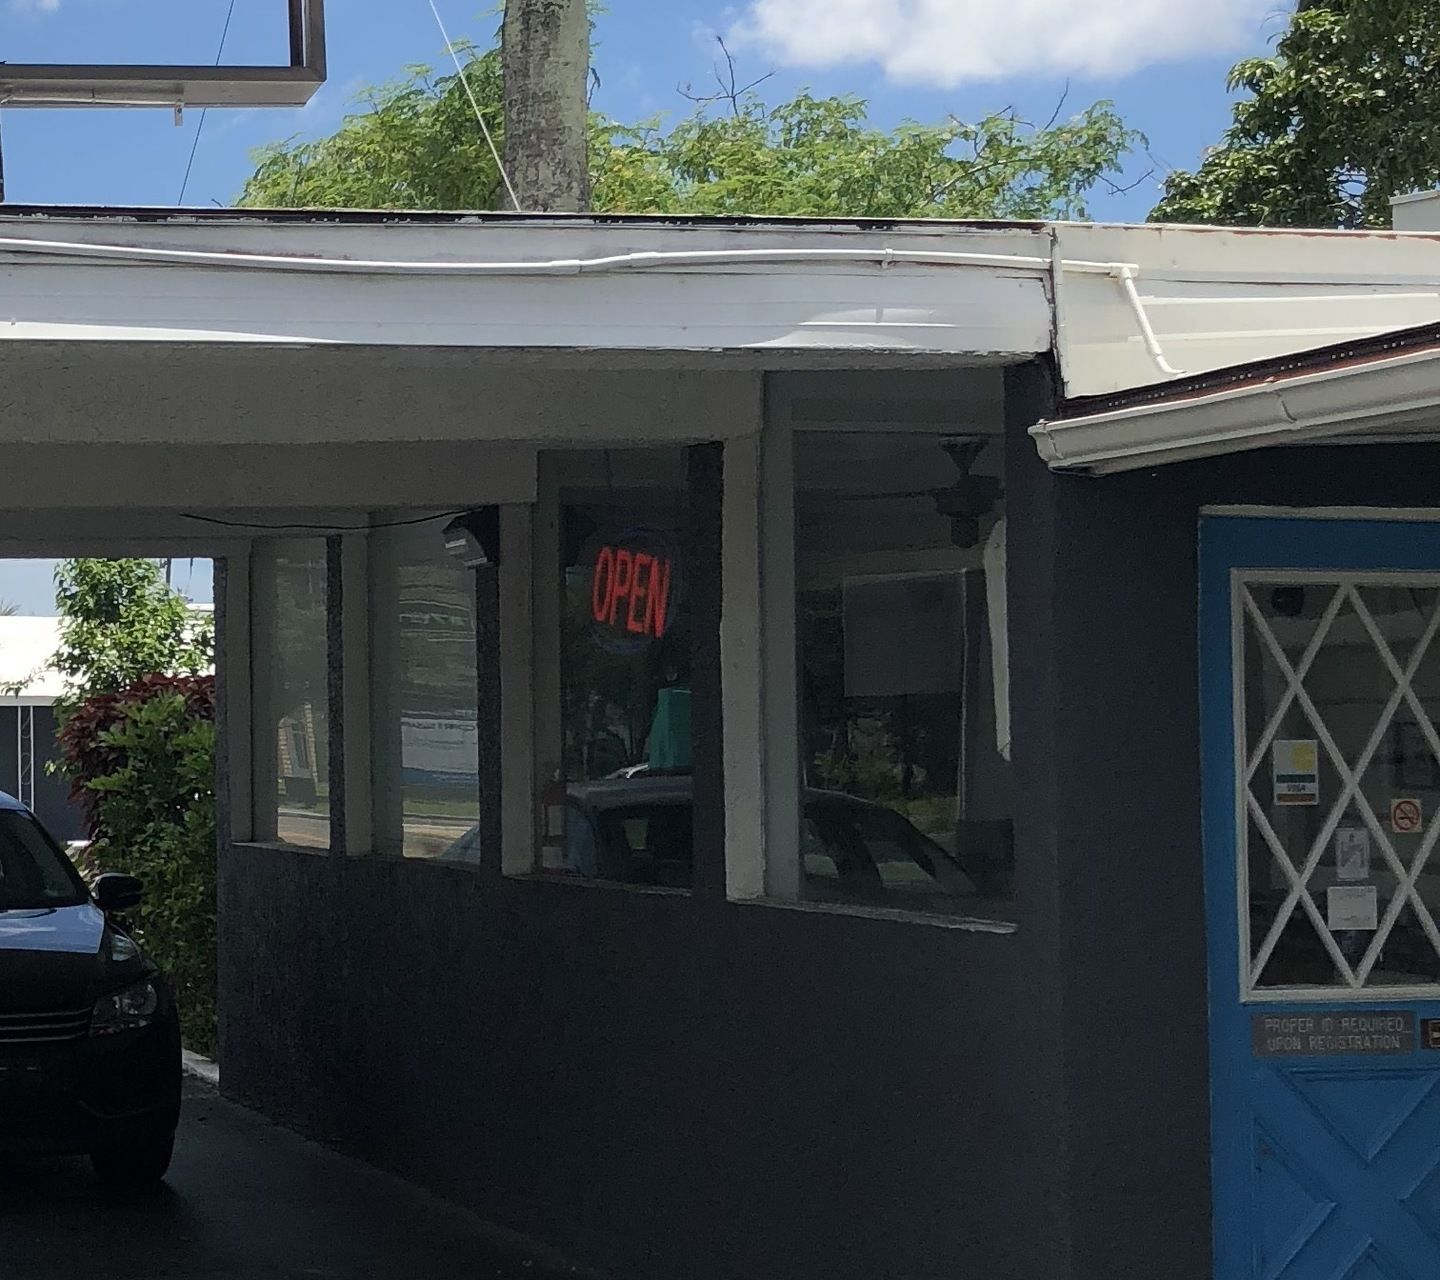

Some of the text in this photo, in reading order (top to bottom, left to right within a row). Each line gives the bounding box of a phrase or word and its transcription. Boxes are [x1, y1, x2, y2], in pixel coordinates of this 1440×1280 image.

[592, 546, 671, 638] OPEN
[1264, 1017, 1314, 1032] PROPER
[1341, 1017, 1404, 1032] REQUIRED
[1266, 1034, 1401, 1051] UPON REGISTRATION
